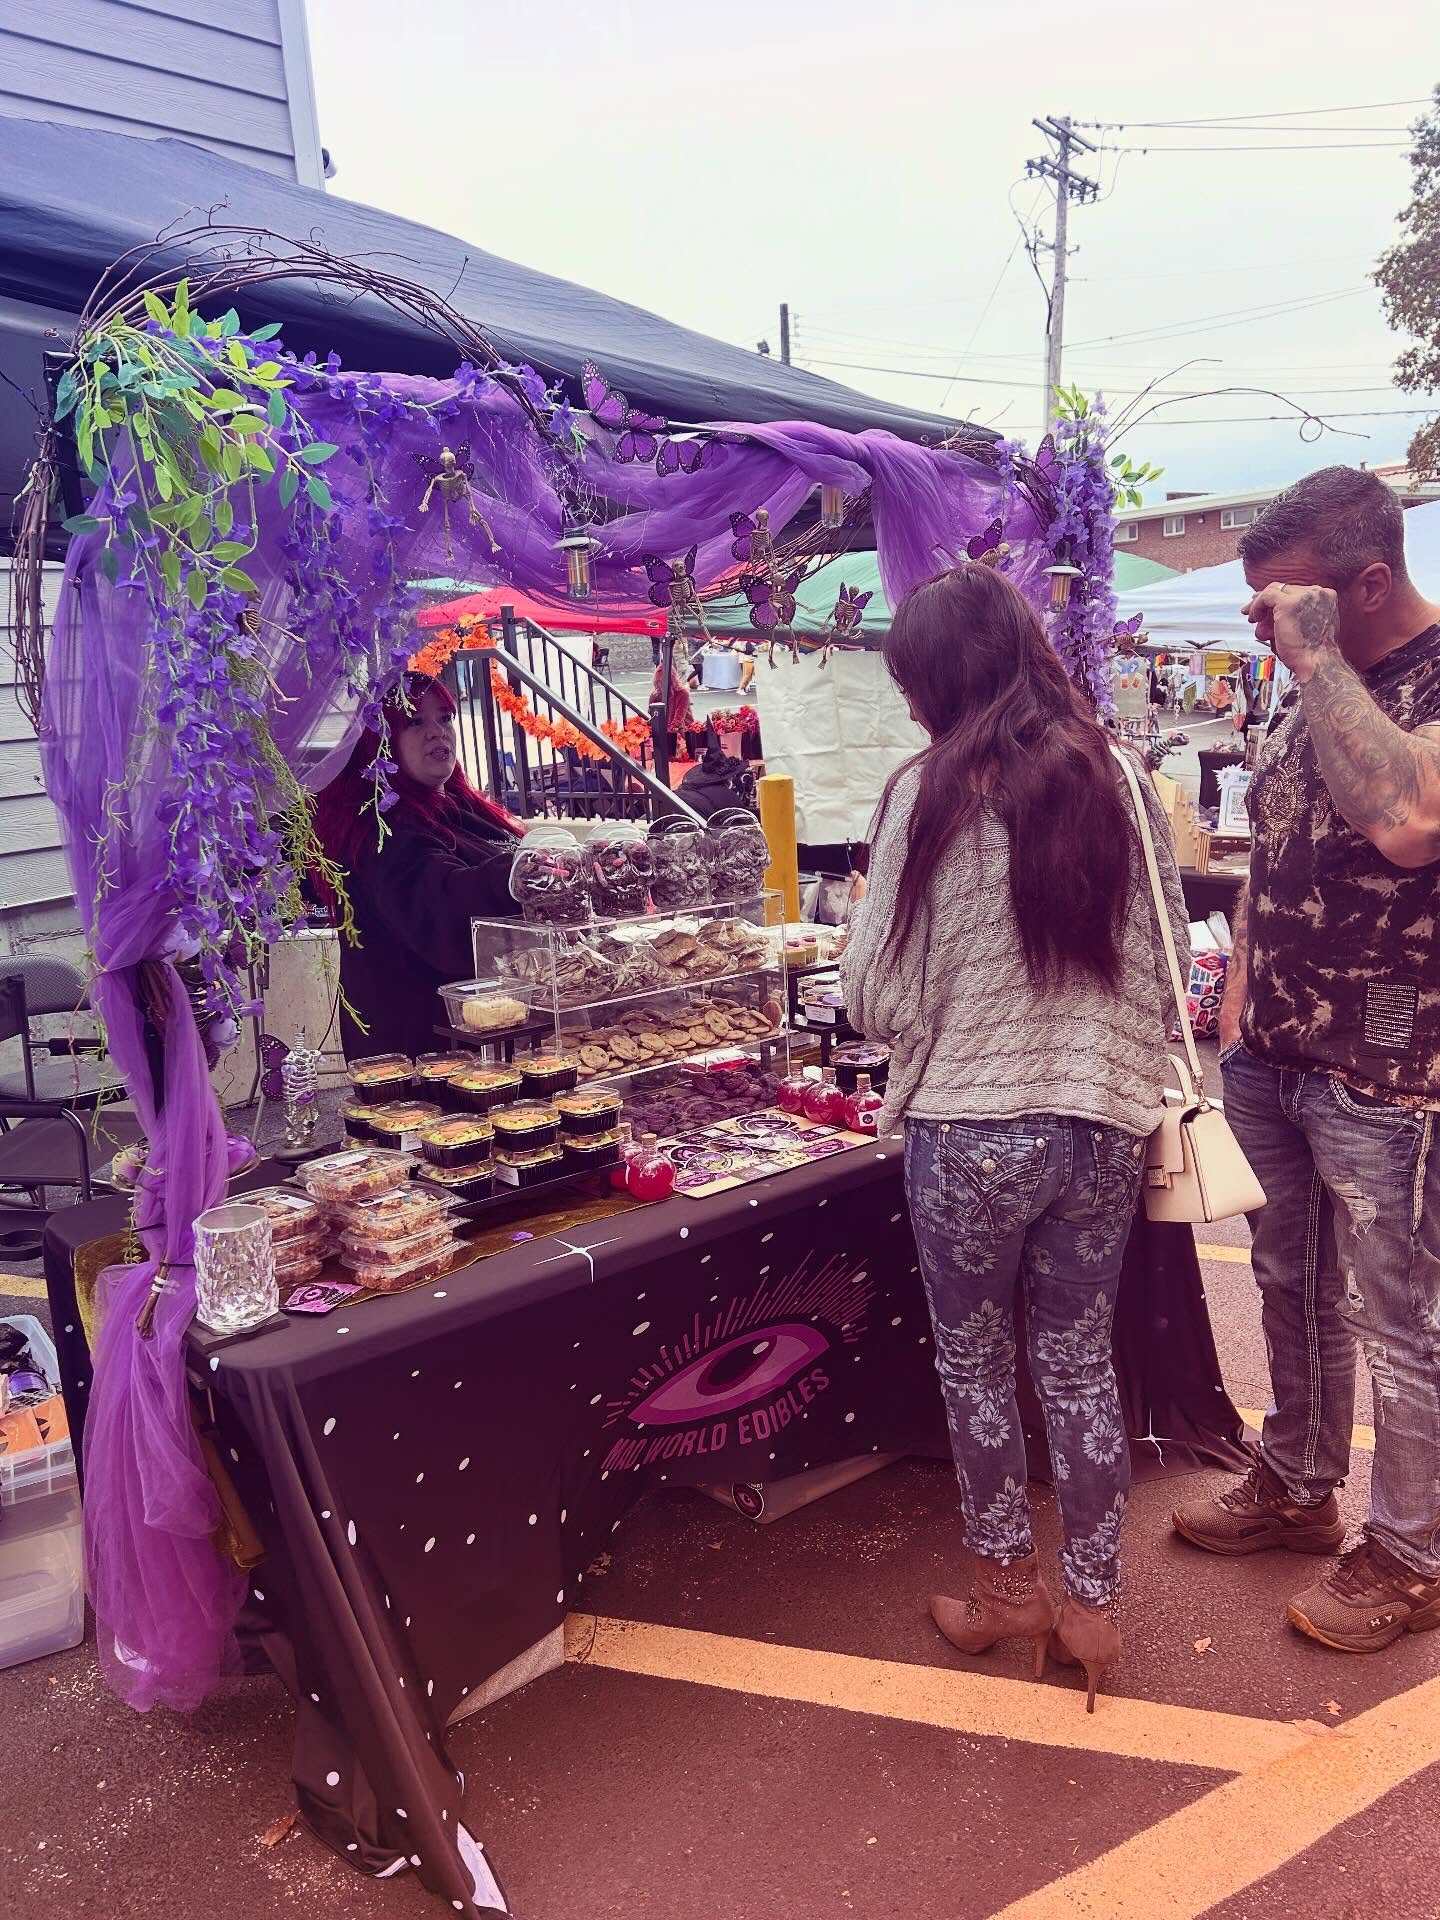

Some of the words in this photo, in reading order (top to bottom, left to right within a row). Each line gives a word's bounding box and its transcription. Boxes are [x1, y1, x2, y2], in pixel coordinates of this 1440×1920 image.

[601, 1438, 647, 1471] MAD
[643, 1423, 727, 1465] WORLD
[738, 1368, 829, 1445] EDIBLES
